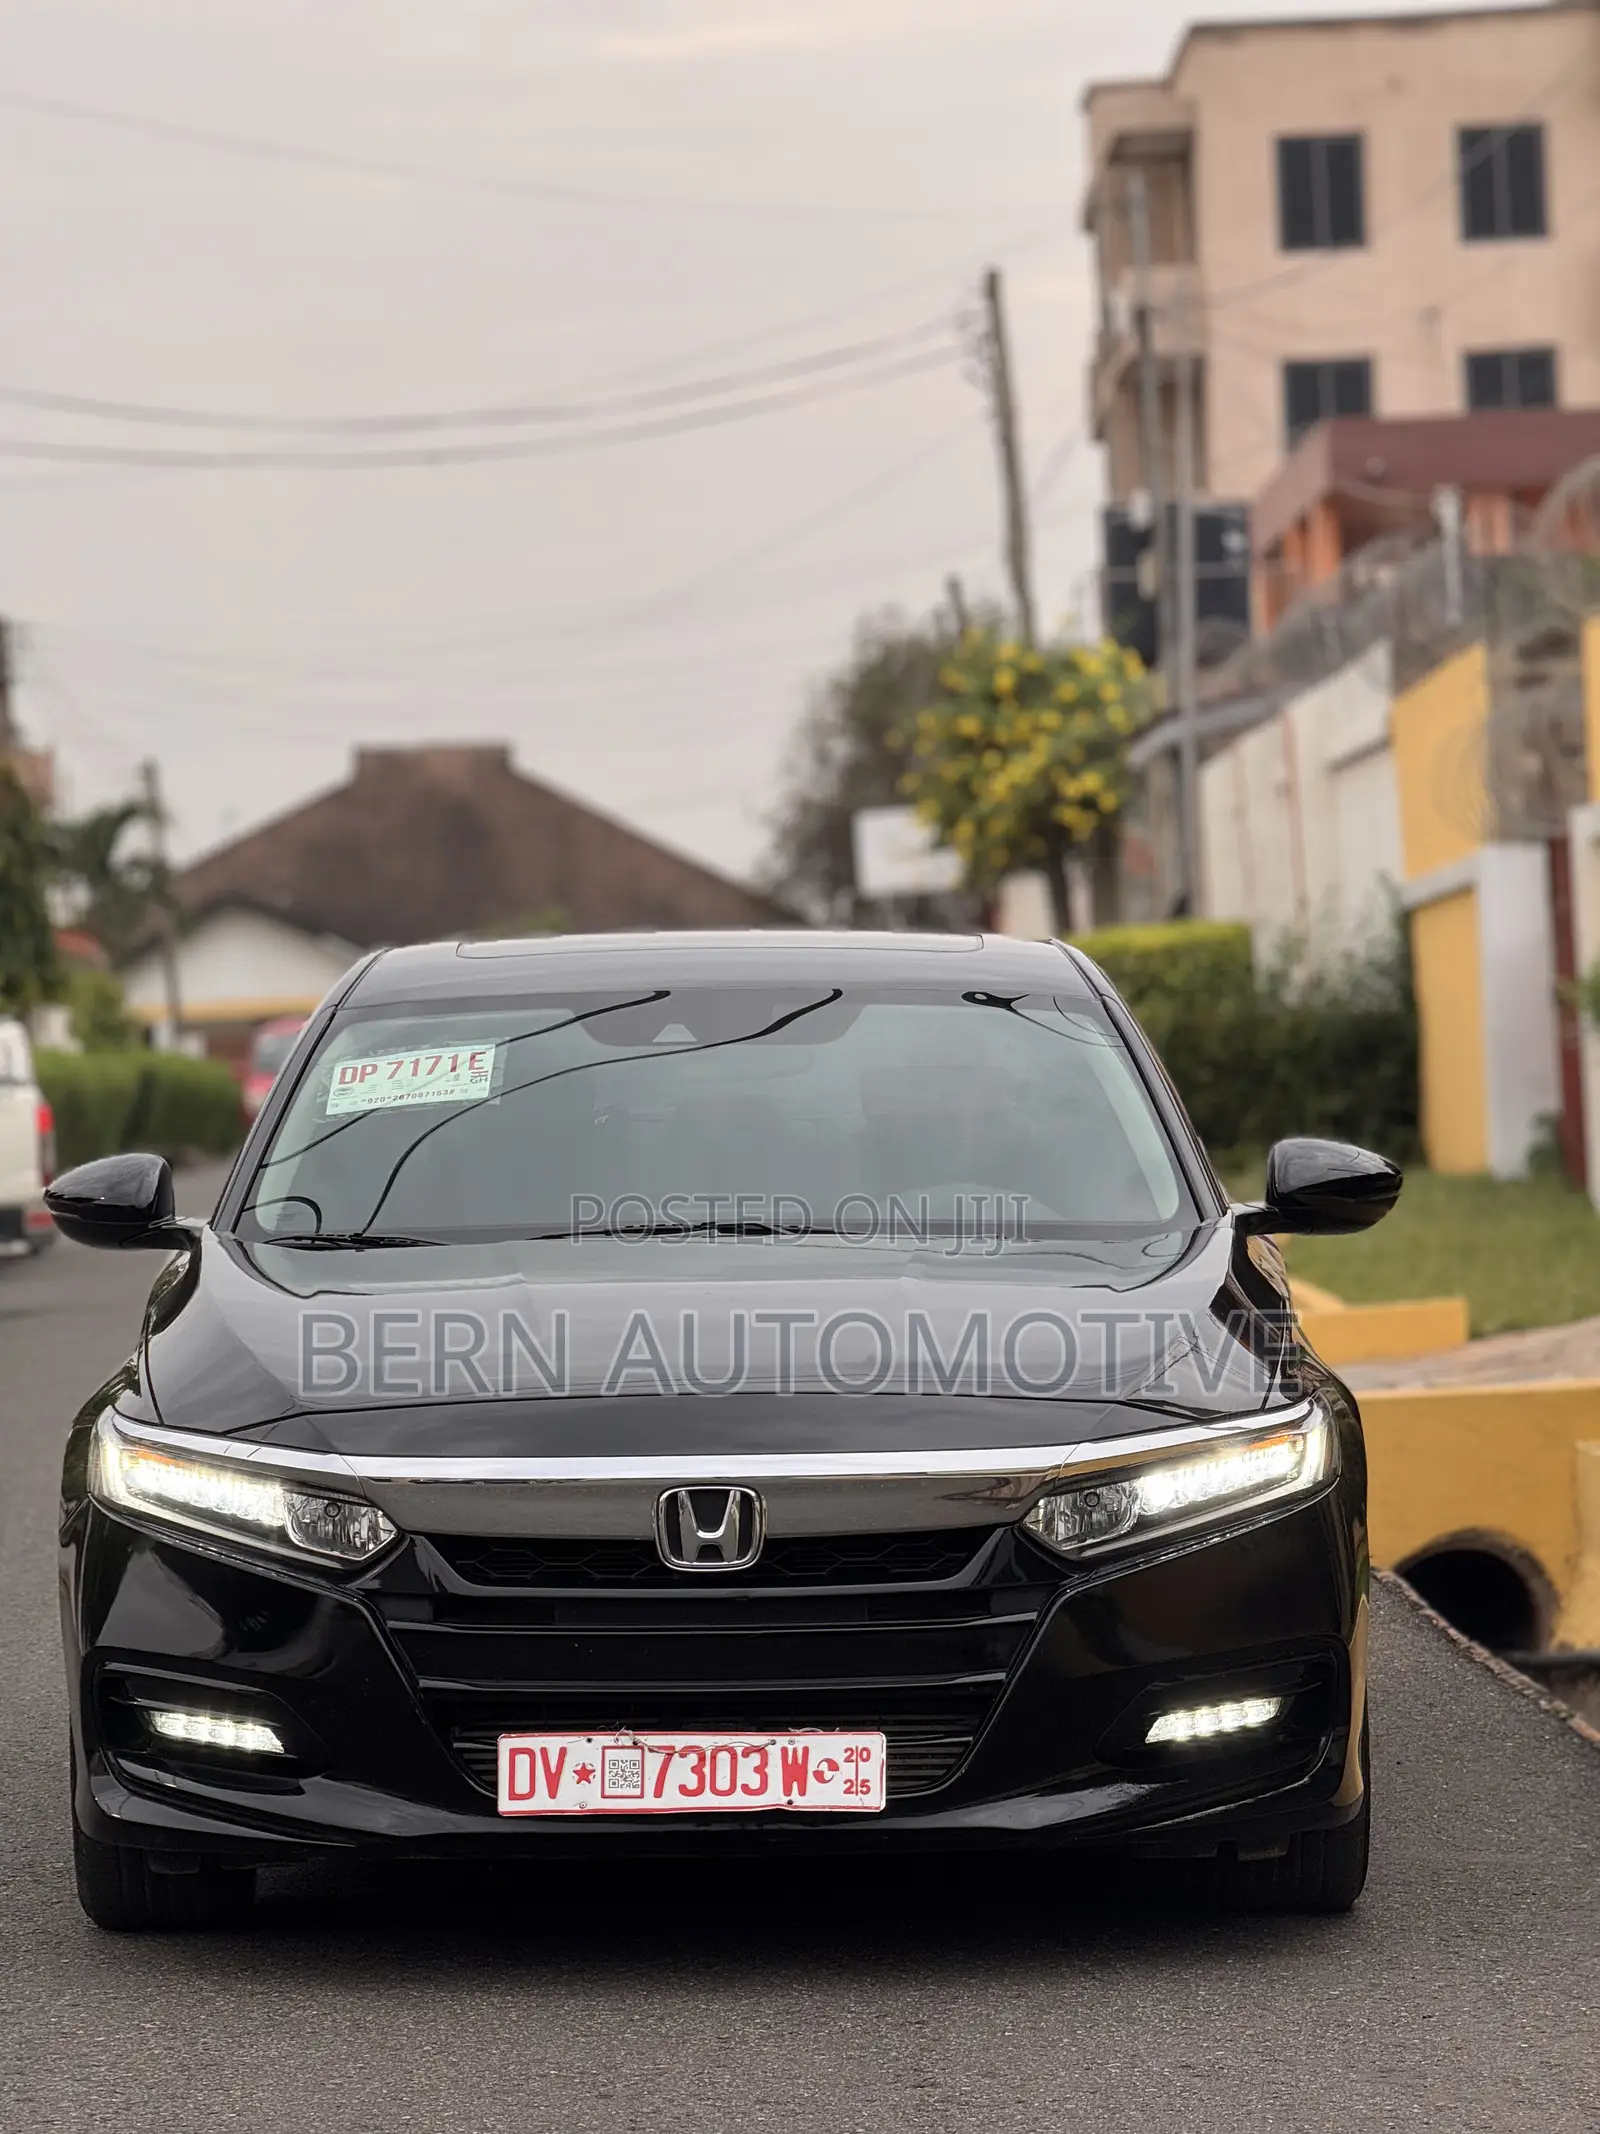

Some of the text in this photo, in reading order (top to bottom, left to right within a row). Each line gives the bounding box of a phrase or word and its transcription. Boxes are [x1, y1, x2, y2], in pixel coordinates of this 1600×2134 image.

[339, 1063, 378, 1085] DP
[386, 1053, 459, 1081] 7171
[468, 1051, 487, 1071] E
[843, 1746, 871, 1763] 20
[508, 1745, 808, 1800] DV 7303 W
[843, 1778, 871, 1796] 25
